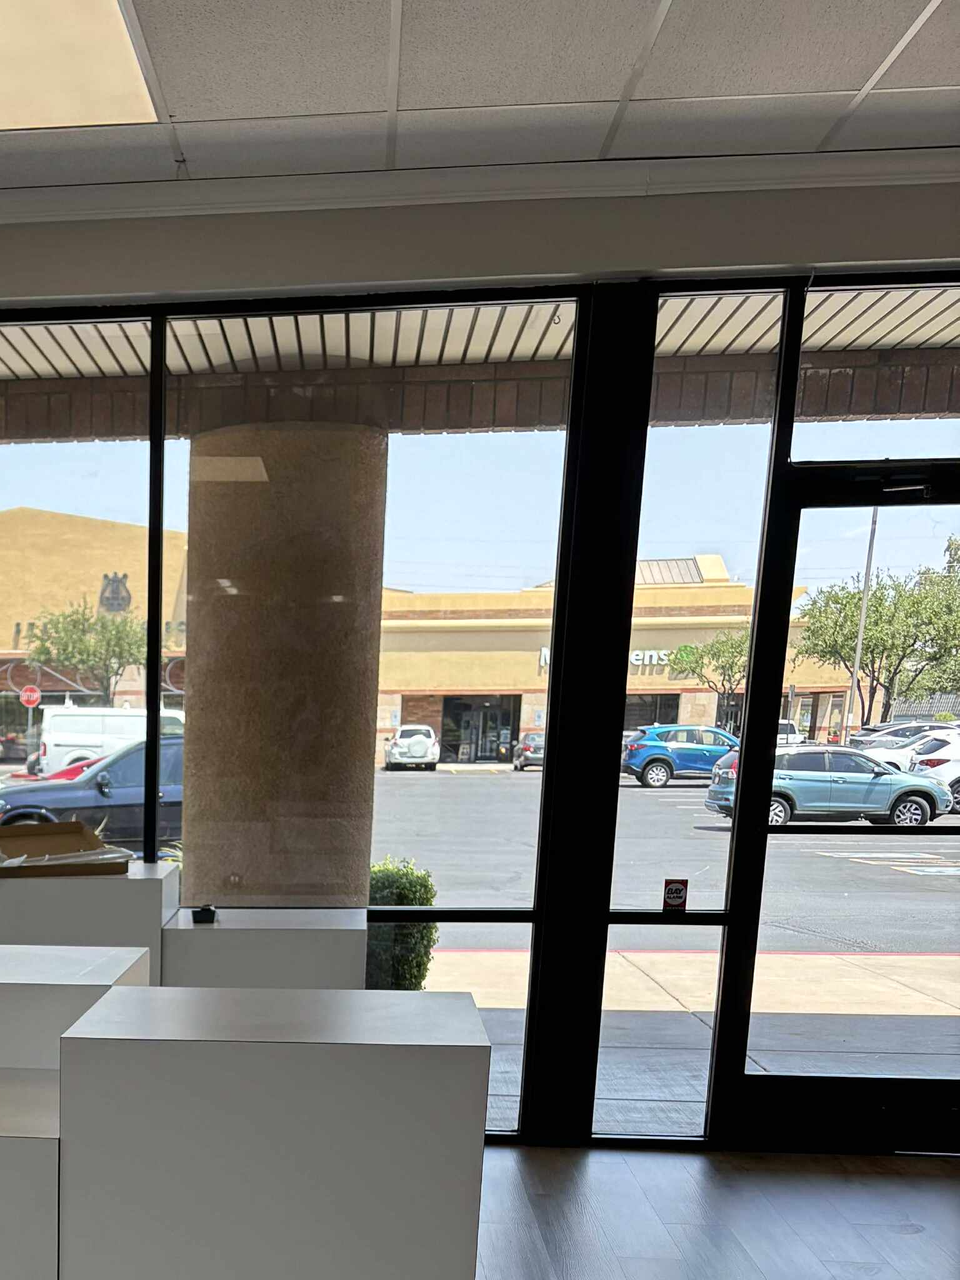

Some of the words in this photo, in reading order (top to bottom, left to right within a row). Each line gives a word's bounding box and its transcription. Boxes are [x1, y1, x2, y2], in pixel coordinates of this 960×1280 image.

[630, 649, 670, 666] ens
[20, 691, 39, 701] STOP
[666, 887, 684, 895] BAY
